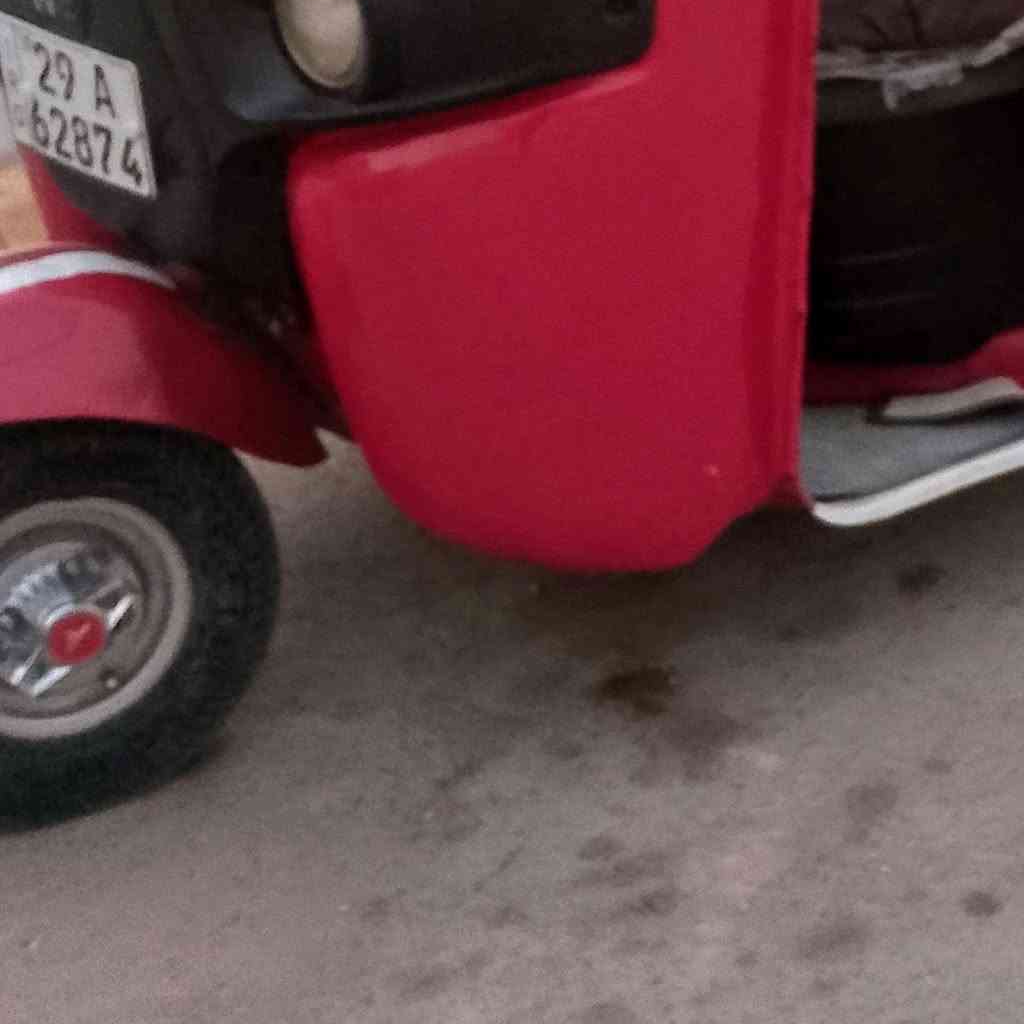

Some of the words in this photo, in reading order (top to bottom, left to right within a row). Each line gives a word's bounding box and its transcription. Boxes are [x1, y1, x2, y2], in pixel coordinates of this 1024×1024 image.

[33, 40, 75, 102] 29
[93, 63, 117, 119] A
[31, 97, 143, 187] 62874
